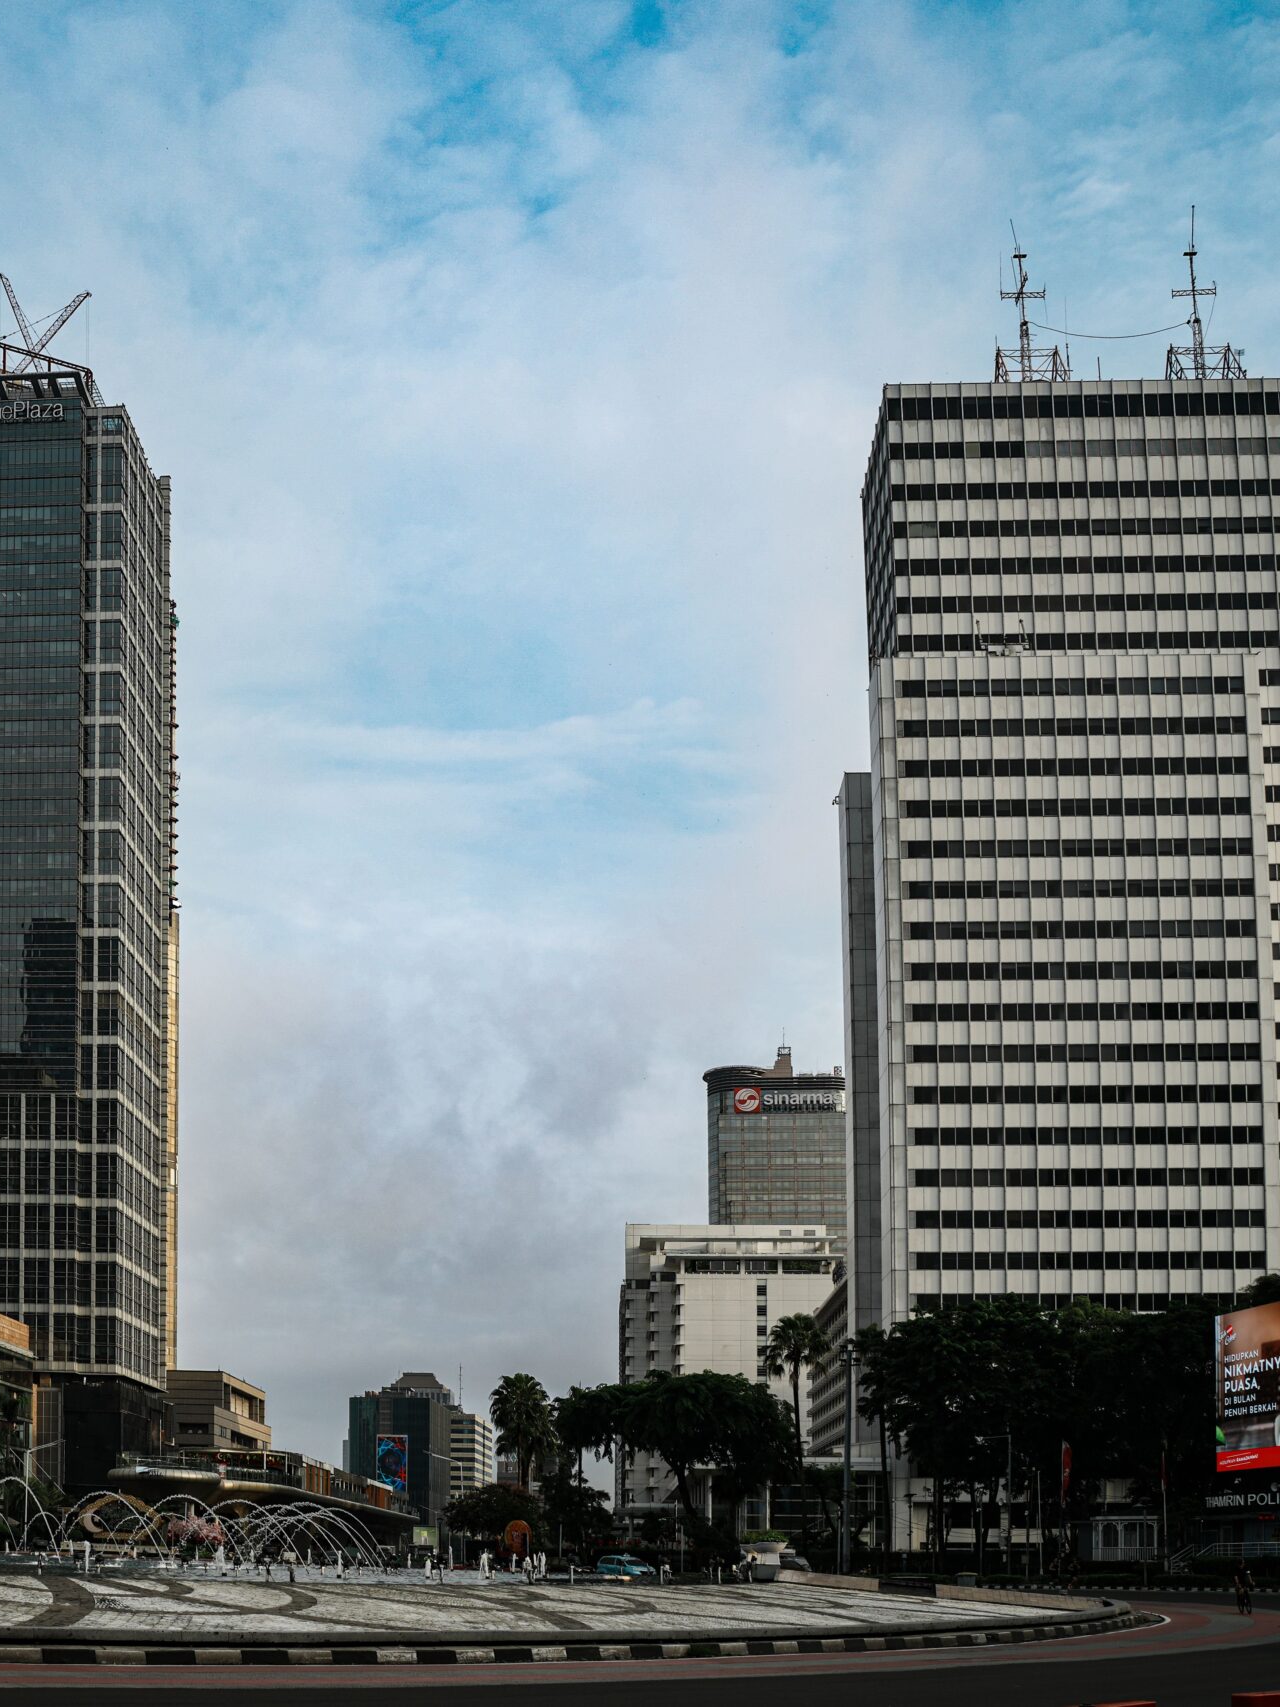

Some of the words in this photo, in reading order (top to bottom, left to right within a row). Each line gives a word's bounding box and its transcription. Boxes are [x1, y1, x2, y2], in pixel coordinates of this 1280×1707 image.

[763, 1091, 843, 1106] sinarmas
[1224, 1349, 1259, 1363] HIDUPKAN
[1224, 1376, 1260, 1394] PUASA,
[1224, 1397, 1232, 1406] DI
[1233, 1393, 1256, 1405] BULAN
[1224, 1406, 1248, 1418] PENUH
[1249, 1402, 1277, 1414] BERKAH
[1205, 1494, 1245, 1509] THAMRIN
